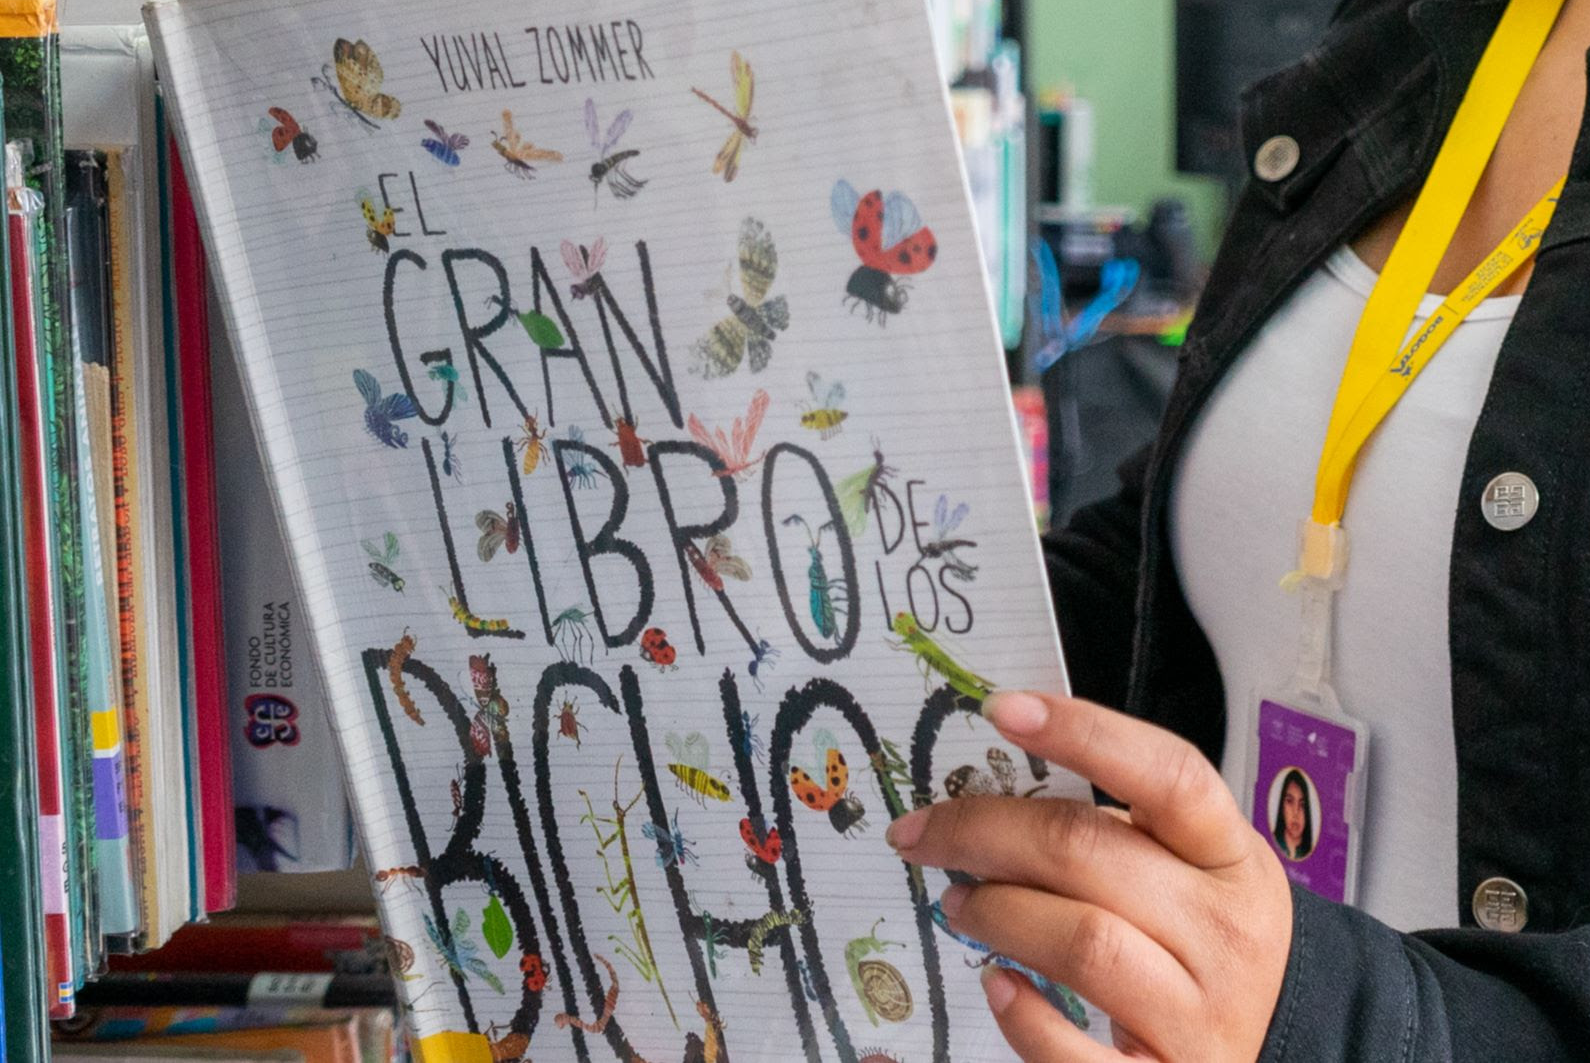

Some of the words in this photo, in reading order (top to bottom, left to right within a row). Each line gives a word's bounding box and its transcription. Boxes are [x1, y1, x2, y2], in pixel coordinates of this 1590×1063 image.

[420, 33, 526, 93] YUVAL
[525, 19, 655, 86] ZOMMER
[378, 170, 447, 237] EL
[383, 239, 684, 430] GRAN
[422, 436, 861, 665] LIBRO
[873, 478, 932, 555] DE
[263, 601, 276, 666] CULTURA
[874, 560, 975, 635] LOS
[249, 636, 262, 688] FONDO
[264, 669, 277, 688] DE
[278, 601, 292, 688] ECONÓMICA
[362, 646, 1052, 1063] BICHO
